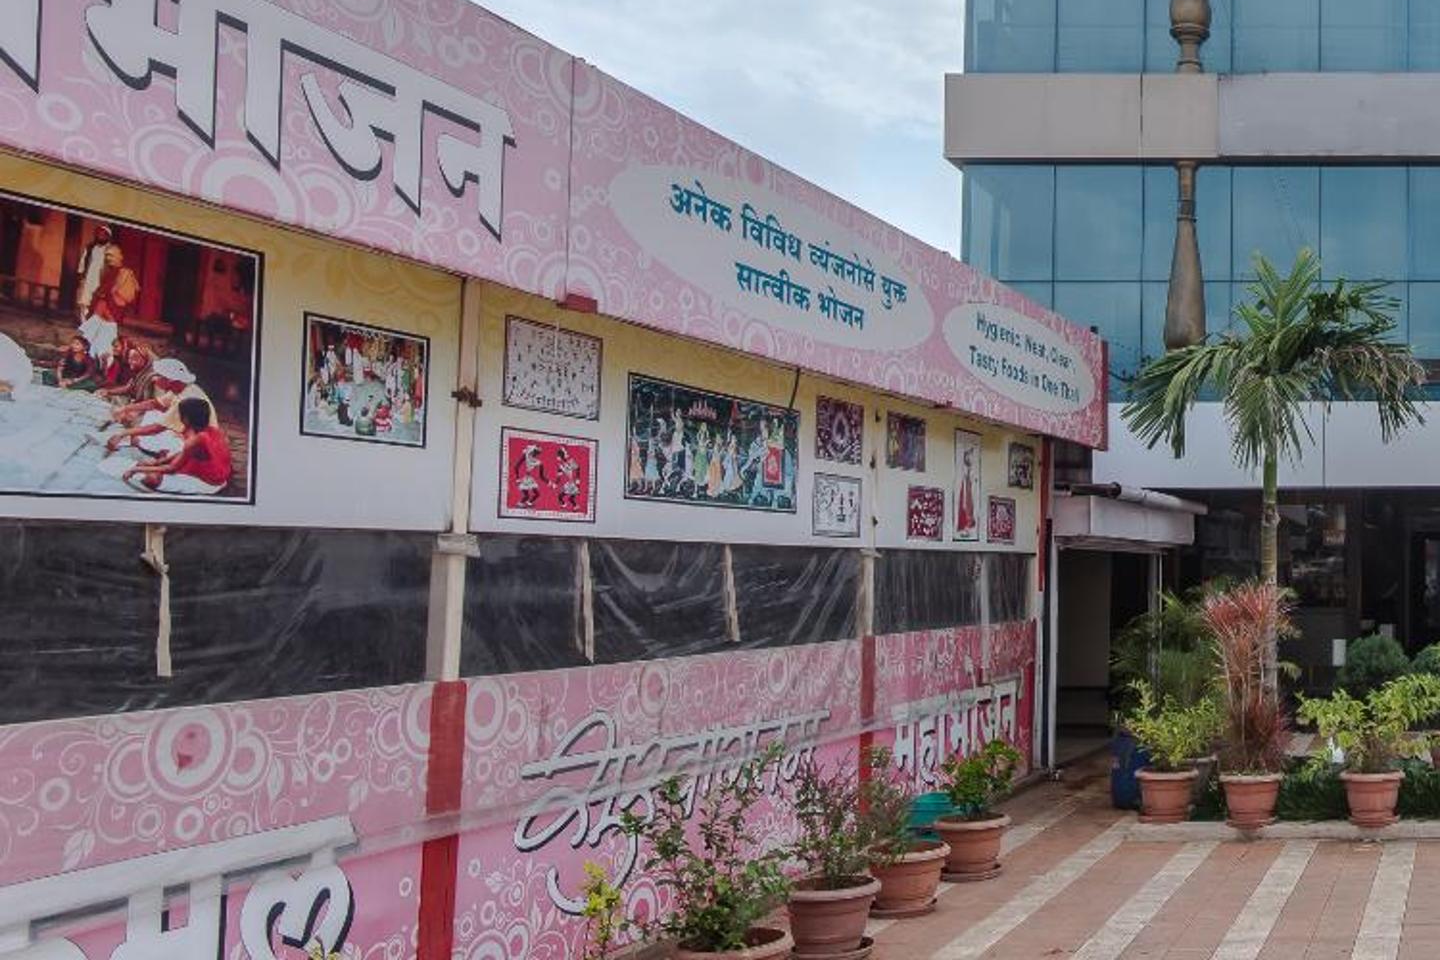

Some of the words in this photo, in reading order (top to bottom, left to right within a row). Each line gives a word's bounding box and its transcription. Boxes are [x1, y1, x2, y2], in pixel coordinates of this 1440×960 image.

[669, 179, 732, 232] अनेक
[741, 202, 802, 260] विविध
[880, 274, 908, 310] युक्त
[735, 260, 811, 312] सात्वीक
[817, 284, 865, 330] भोजन
